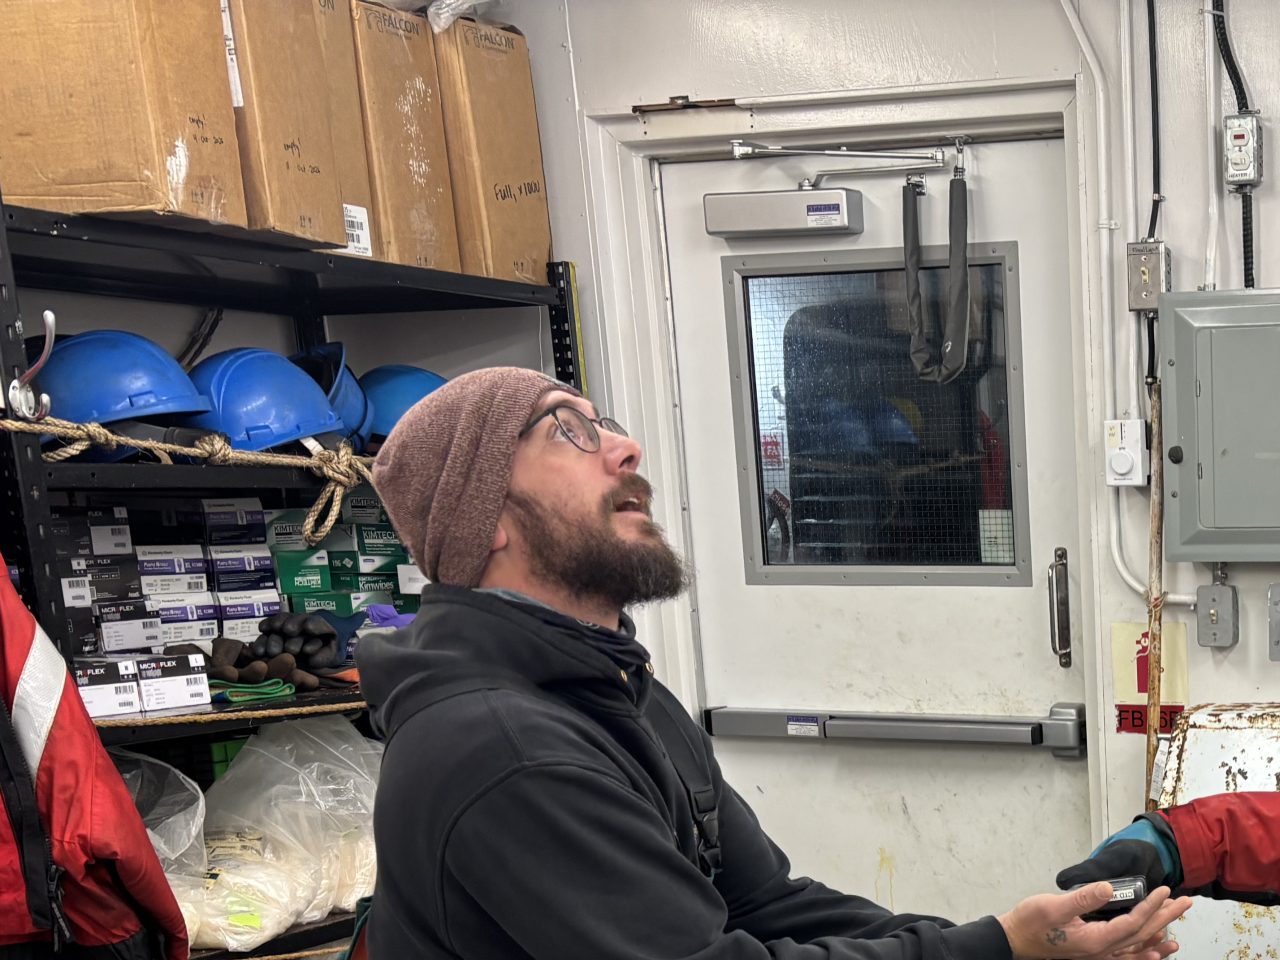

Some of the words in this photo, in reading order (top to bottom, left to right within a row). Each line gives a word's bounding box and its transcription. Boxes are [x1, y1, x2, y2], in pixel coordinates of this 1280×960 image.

[381, 14, 420, 36] FALCON
[478, 32, 515, 49] FALCON
[139, 660, 177, 670] MICROFLEX
